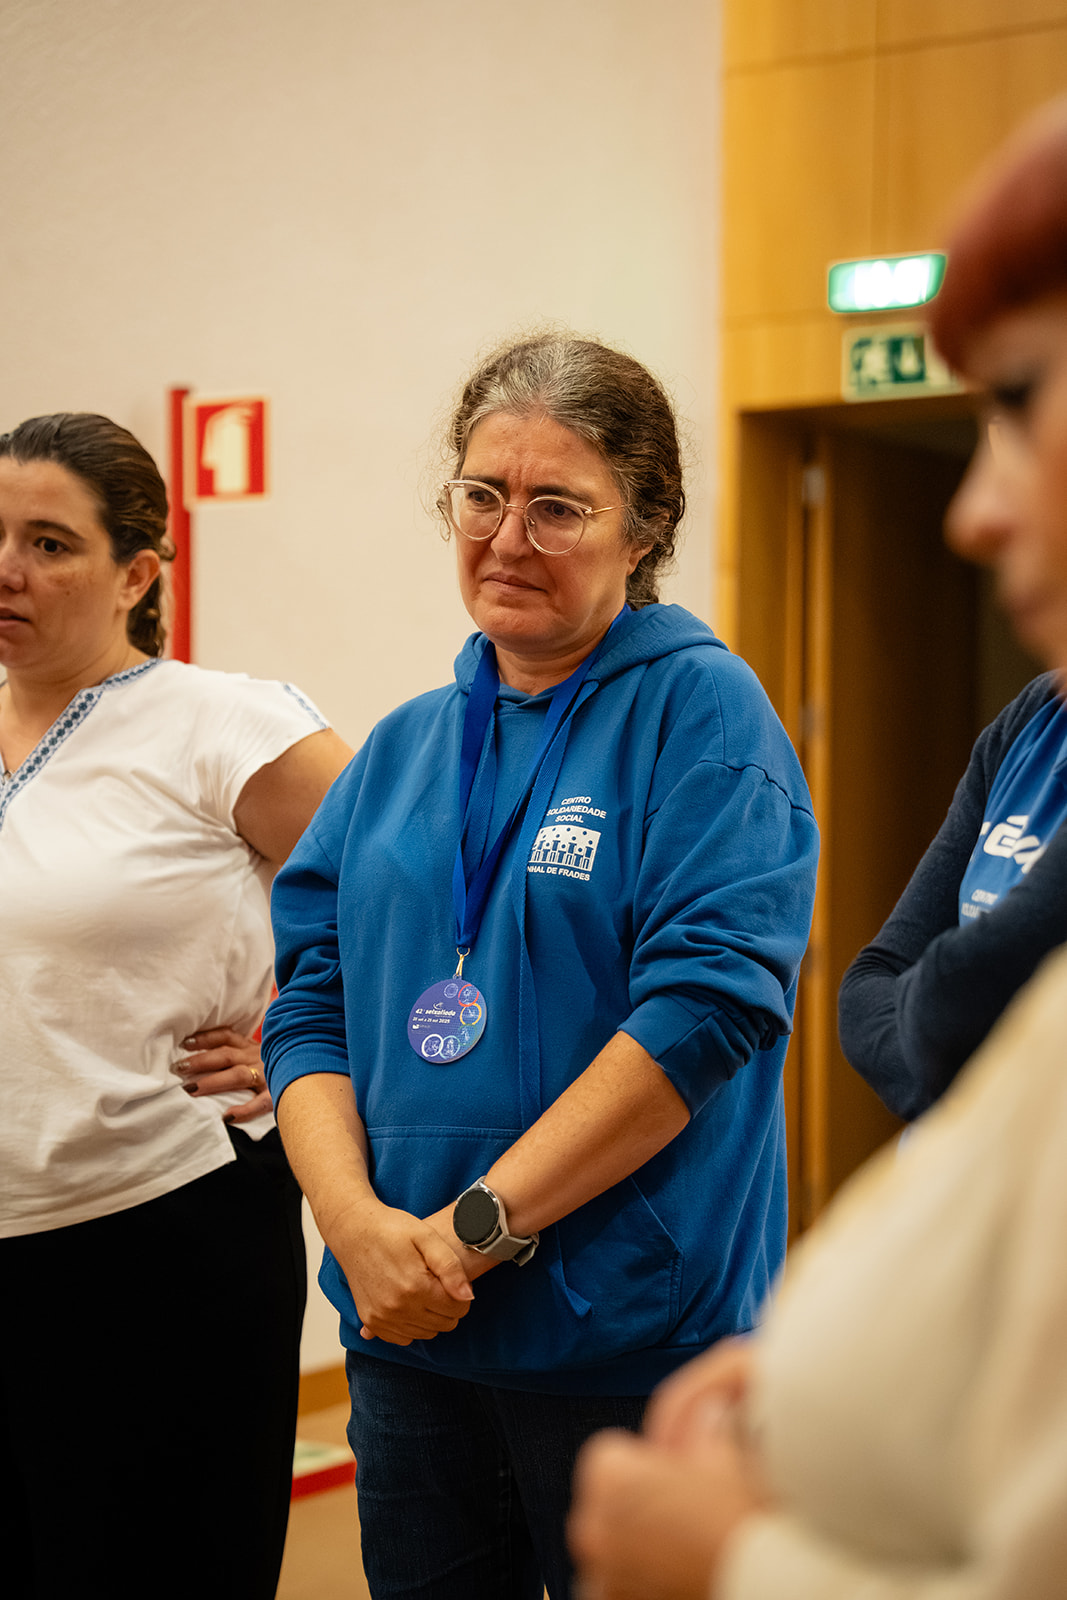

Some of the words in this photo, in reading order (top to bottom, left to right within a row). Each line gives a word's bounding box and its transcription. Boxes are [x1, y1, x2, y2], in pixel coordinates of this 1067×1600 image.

[561, 796, 591, 806] CENTRO
[546, 805, 607, 819] SOLIDARIEDADE
[555, 814, 584, 823] SOCIAL
[527, 865, 545, 873] NHAL
[546, 866, 557, 875] DE
[558, 868, 590, 881] FRADES
